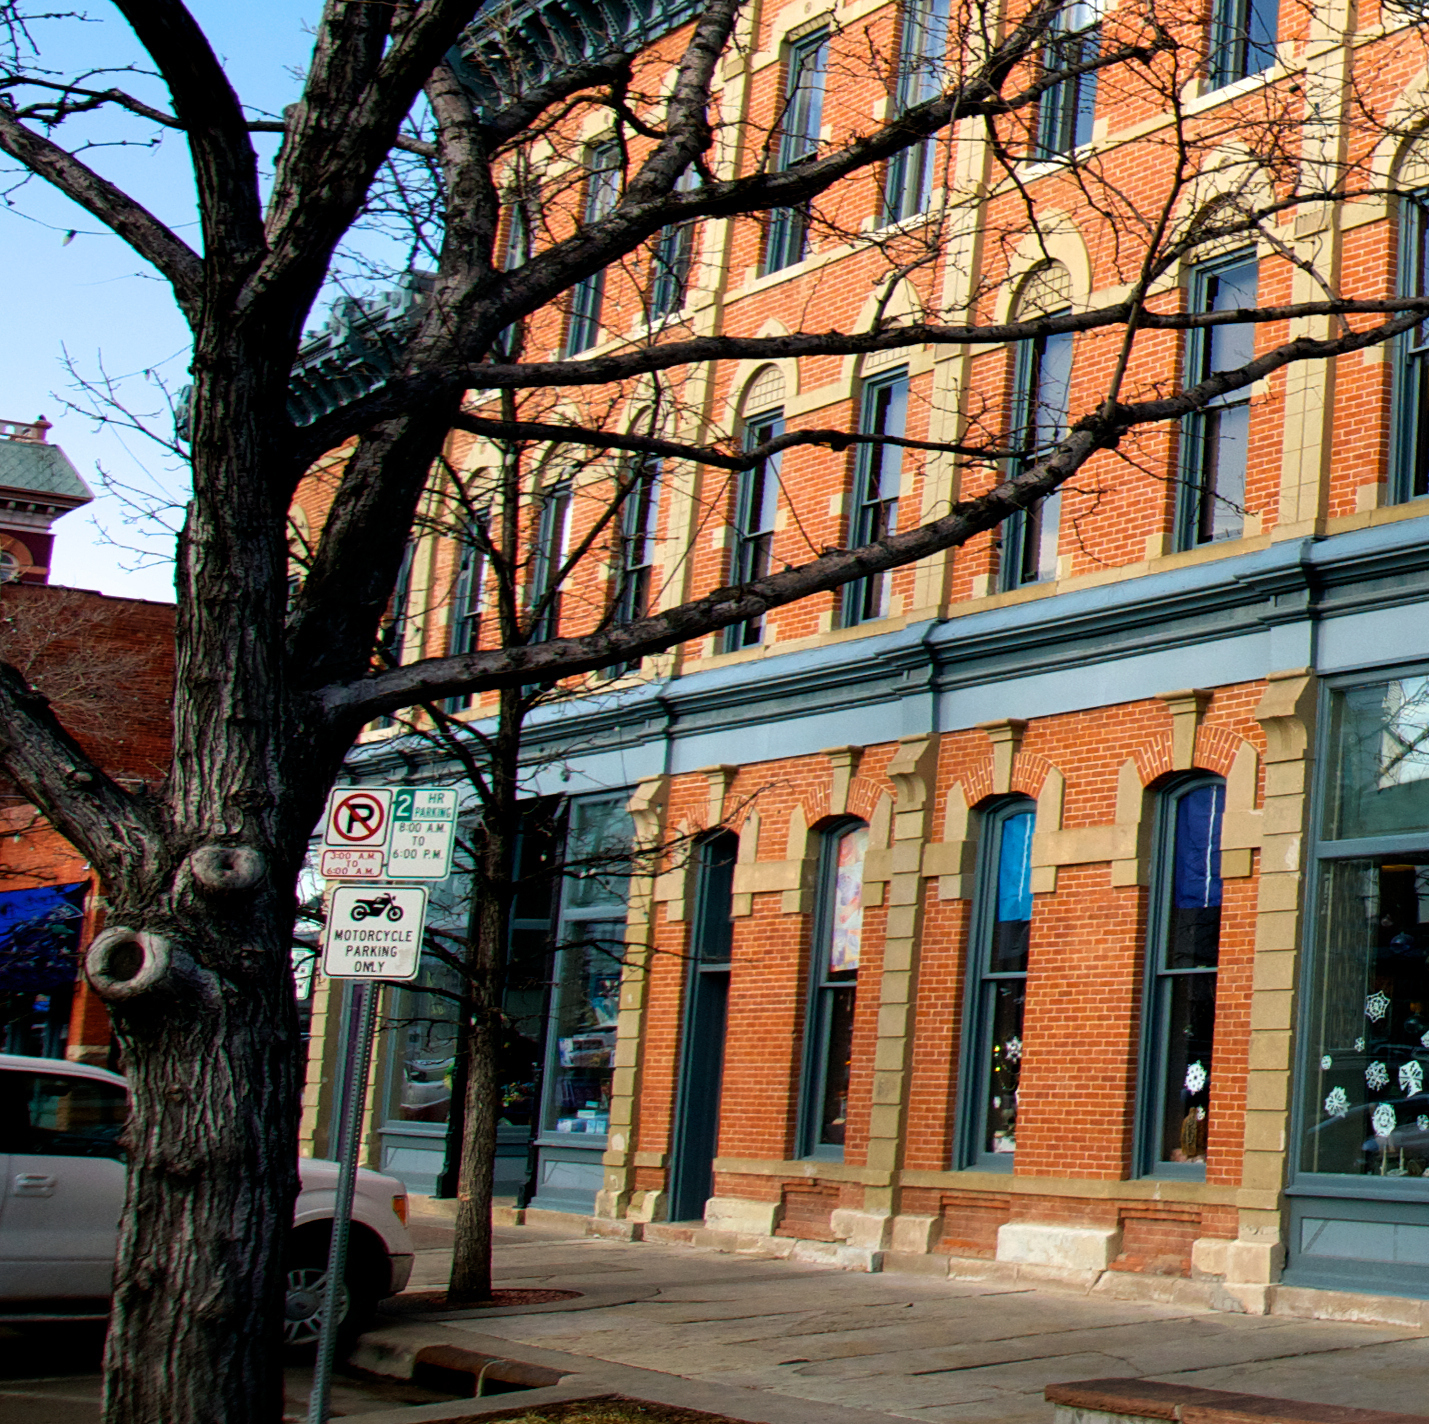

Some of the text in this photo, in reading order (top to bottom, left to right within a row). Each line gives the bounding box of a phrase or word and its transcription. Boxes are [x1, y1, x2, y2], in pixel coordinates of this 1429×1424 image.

[396, 793, 445, 816] 2 HR
[413, 807, 452, 819] PARKING
[398, 822, 447, 833] 8:00 A.M.
[412, 835, 426, 847] TO
[392, 848, 444, 860] 6:00 P.M.
[346, 860, 359, 868] TO
[326, 867, 349, 875] 6:00
[333, 929, 414, 943] MOTORCYCLE
[345, 945, 399, 958] PARKING
[353, 960, 386, 973] ONLY
